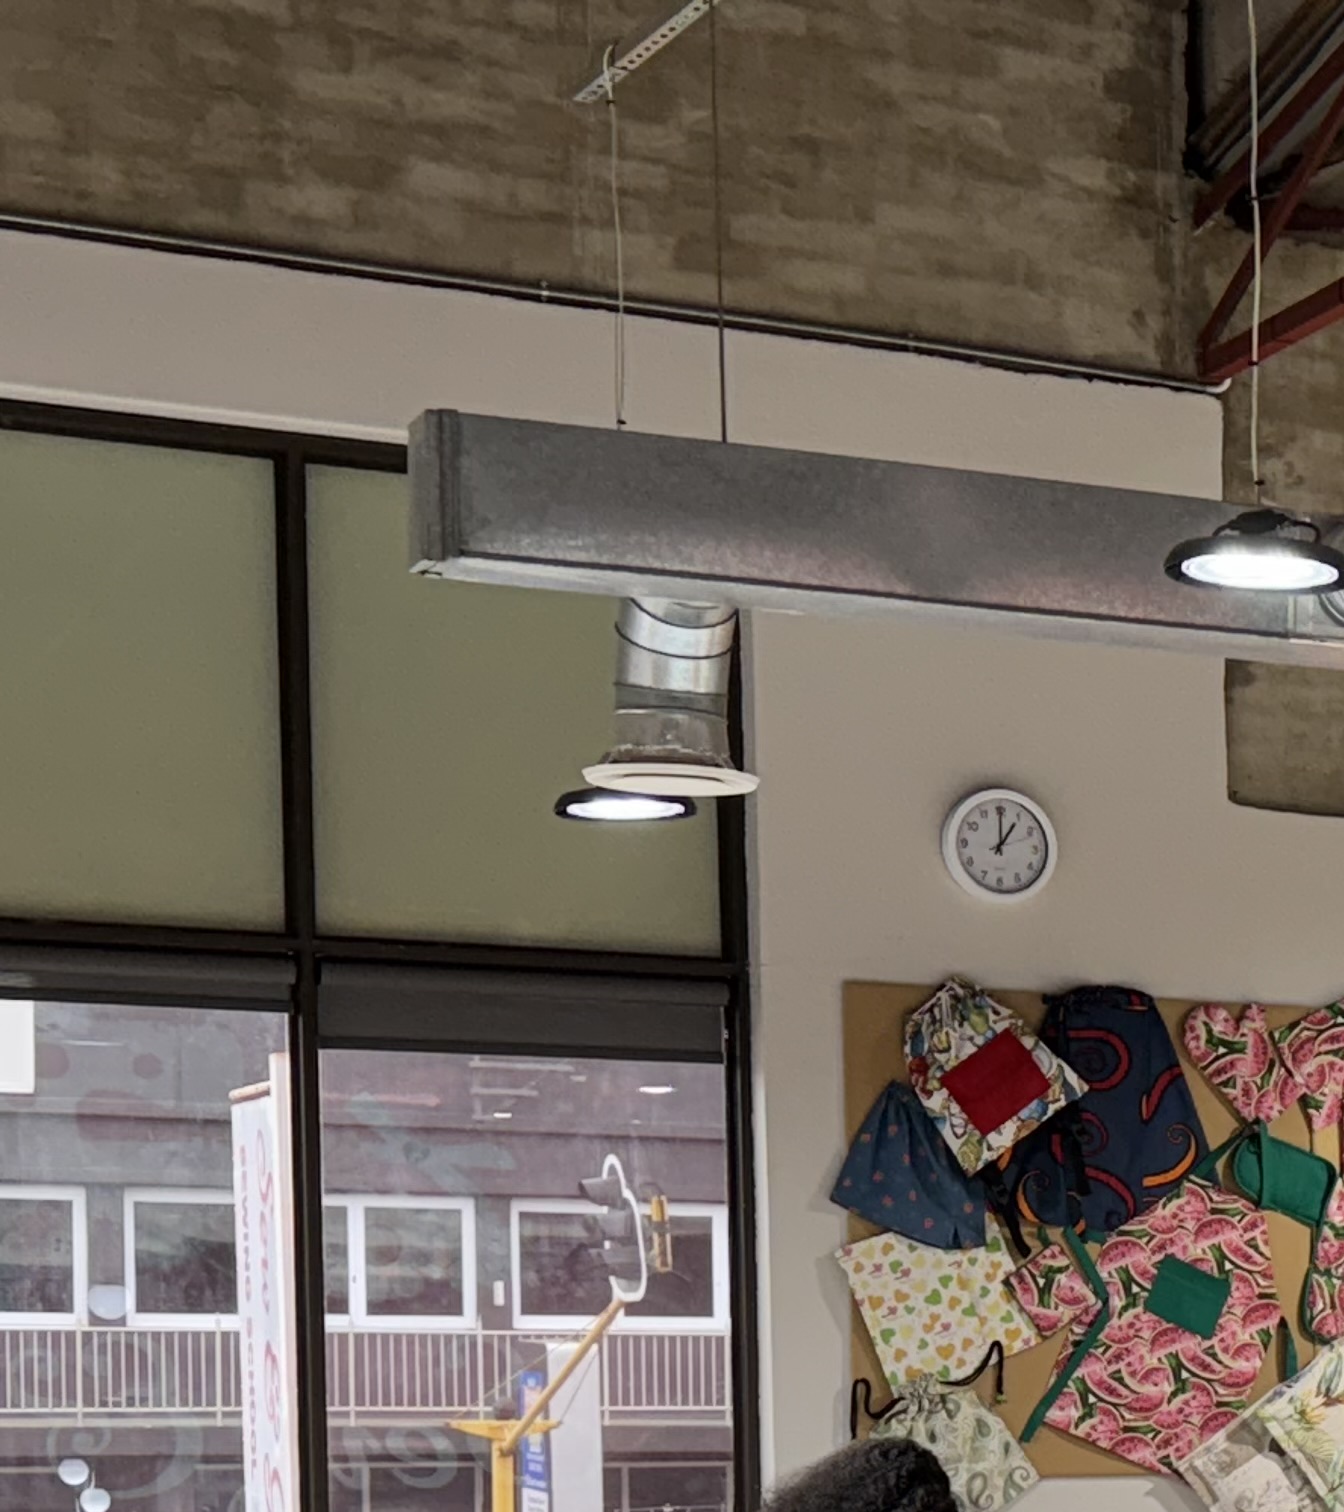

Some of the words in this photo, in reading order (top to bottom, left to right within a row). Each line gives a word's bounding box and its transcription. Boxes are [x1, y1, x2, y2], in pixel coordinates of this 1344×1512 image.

[981, 870, 988, 881] 7
[239, 1144, 253, 1303] SEWING
[245, 1316, 257, 1480] SCHOOL
